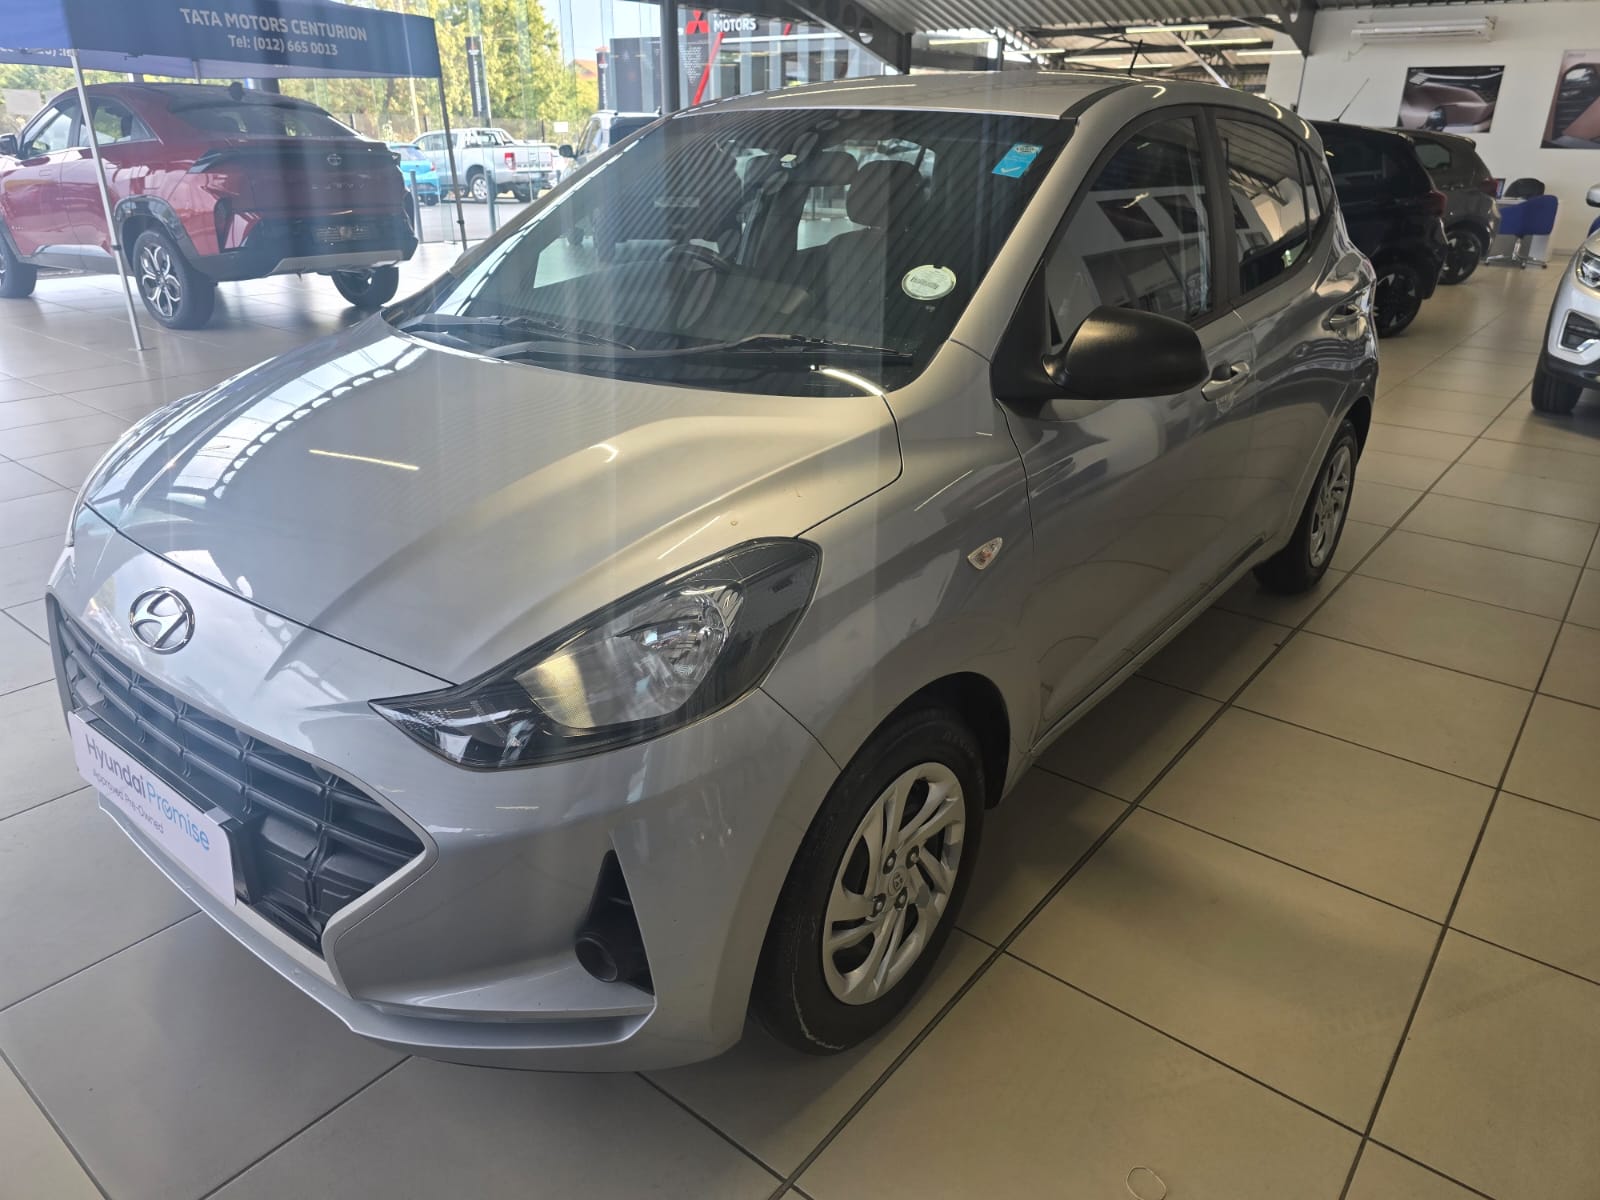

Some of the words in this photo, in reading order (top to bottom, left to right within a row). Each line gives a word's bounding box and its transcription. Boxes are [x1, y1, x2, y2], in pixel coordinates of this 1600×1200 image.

[180, 8, 222, 27] TATA
[225, 12, 288, 33] MOTORS
[291, 19, 367, 41] CENTURION
[714, 18, 757, 32] MOTORS
[228, 35, 250, 48] Tel:
[253, 36, 284, 53] (012)
[287, 40, 308, 53] 665
[311, 42, 338, 56] 0013
[85, 733, 146, 799] Hyundai
